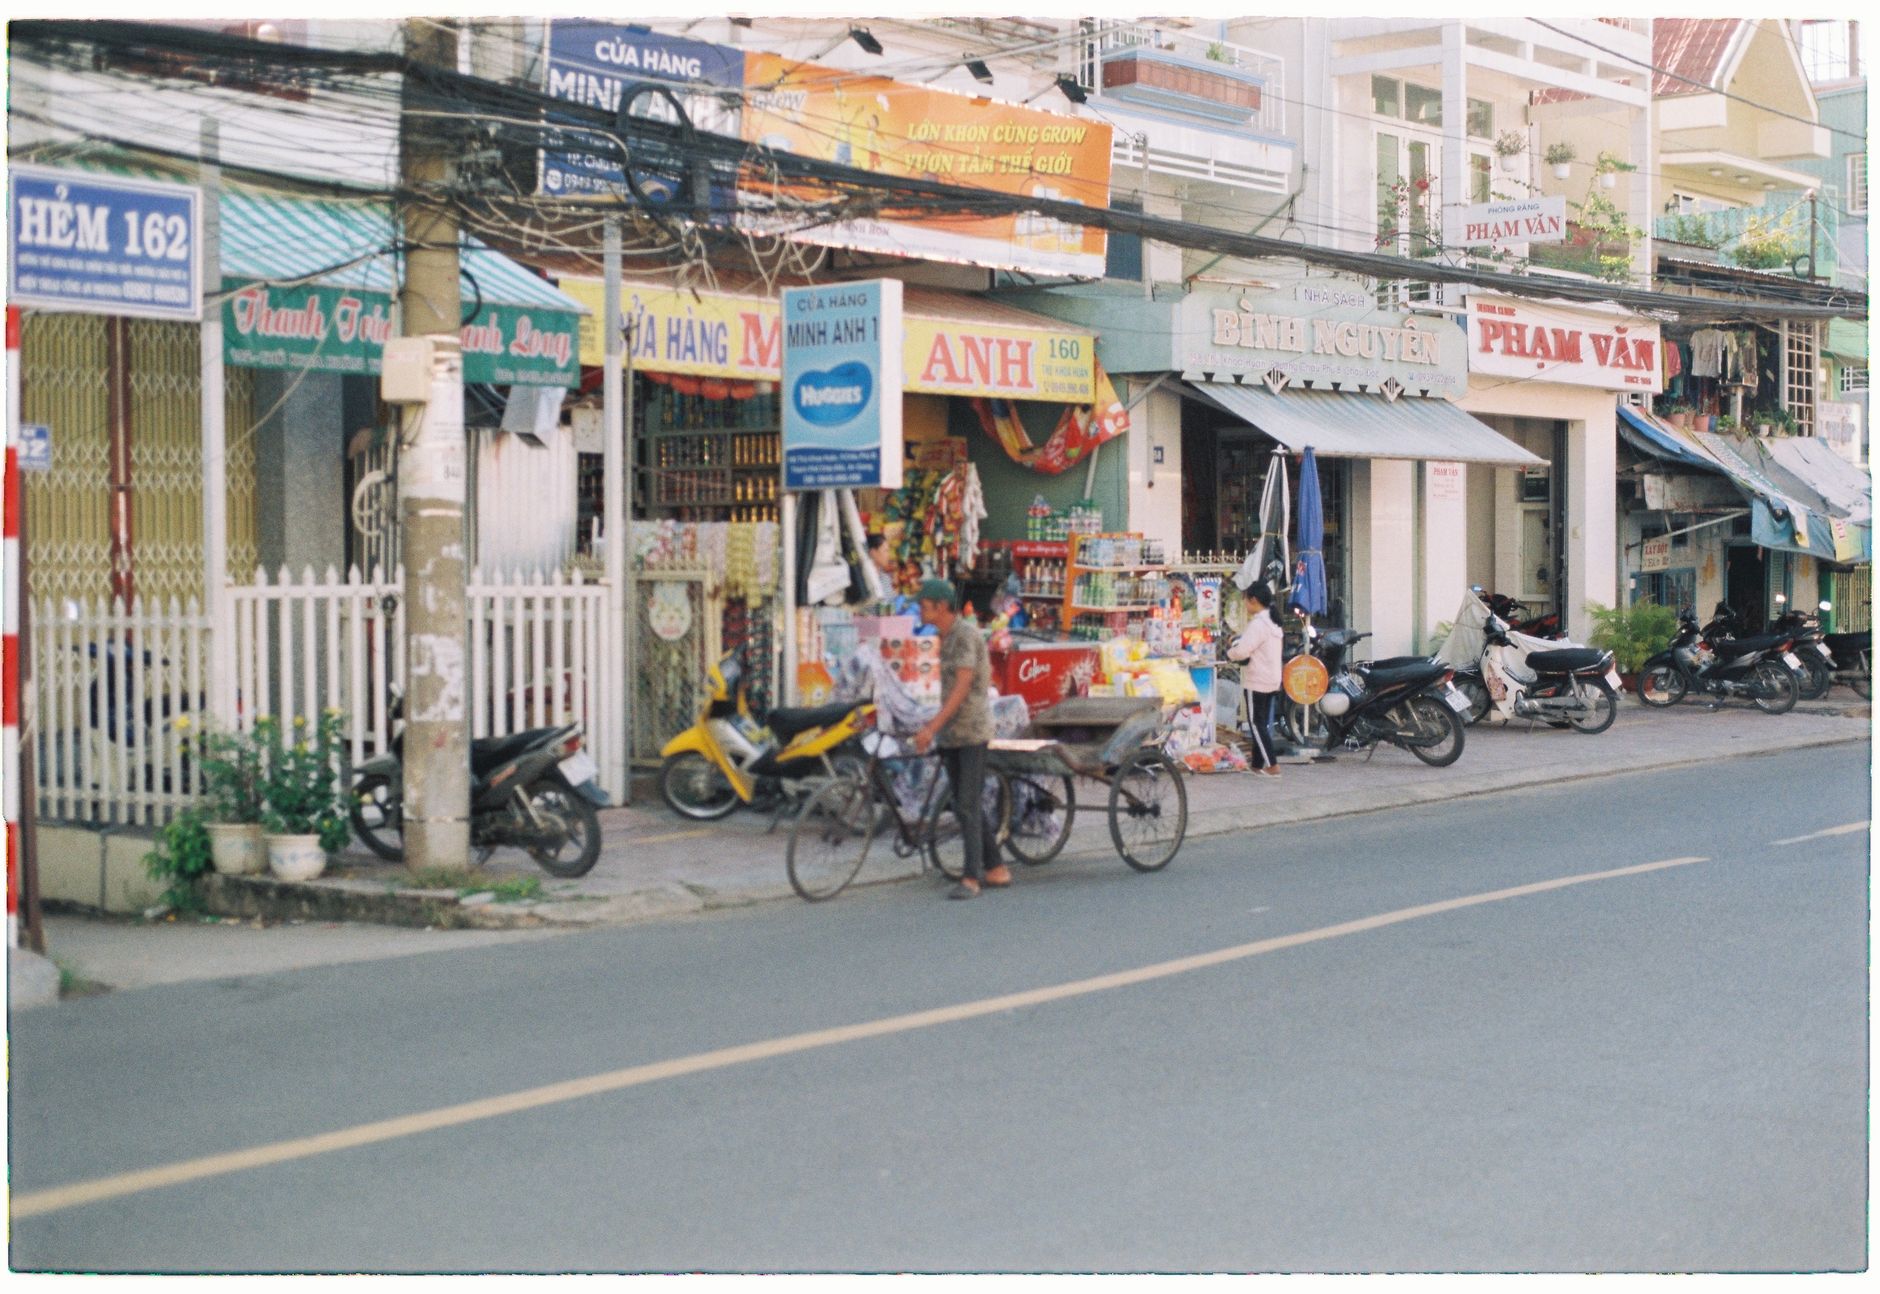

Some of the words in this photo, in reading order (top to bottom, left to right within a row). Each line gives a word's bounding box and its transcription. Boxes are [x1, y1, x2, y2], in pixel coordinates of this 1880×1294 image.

[643, 47, 702, 78] HÀNG
[992, 119, 1039, 144] CÙNG
[1041, 125, 1087, 146] GROW
[18, 183, 111, 253] HẺM
[123, 211, 189, 262] 162
[1465, 218, 1520, 243] PHẠM
[1524, 213, 1561, 236] VĂN
[231, 287, 328, 341] Thanh
[508, 314, 571, 369] Long
[666, 305, 728, 365] HÀNG
[921, 331, 1038, 391] ANH
[1048, 338, 1080, 360] 160
[787, 320, 827, 348] MINH
[832, 317, 866, 346] ANH
[1212, 299, 1306, 353] BÌNH
[1312, 316, 1441, 365] NGUYÊN
[1477, 318, 1584, 370] PHẠM
[1588, 325, 1656, 372] VĂN
